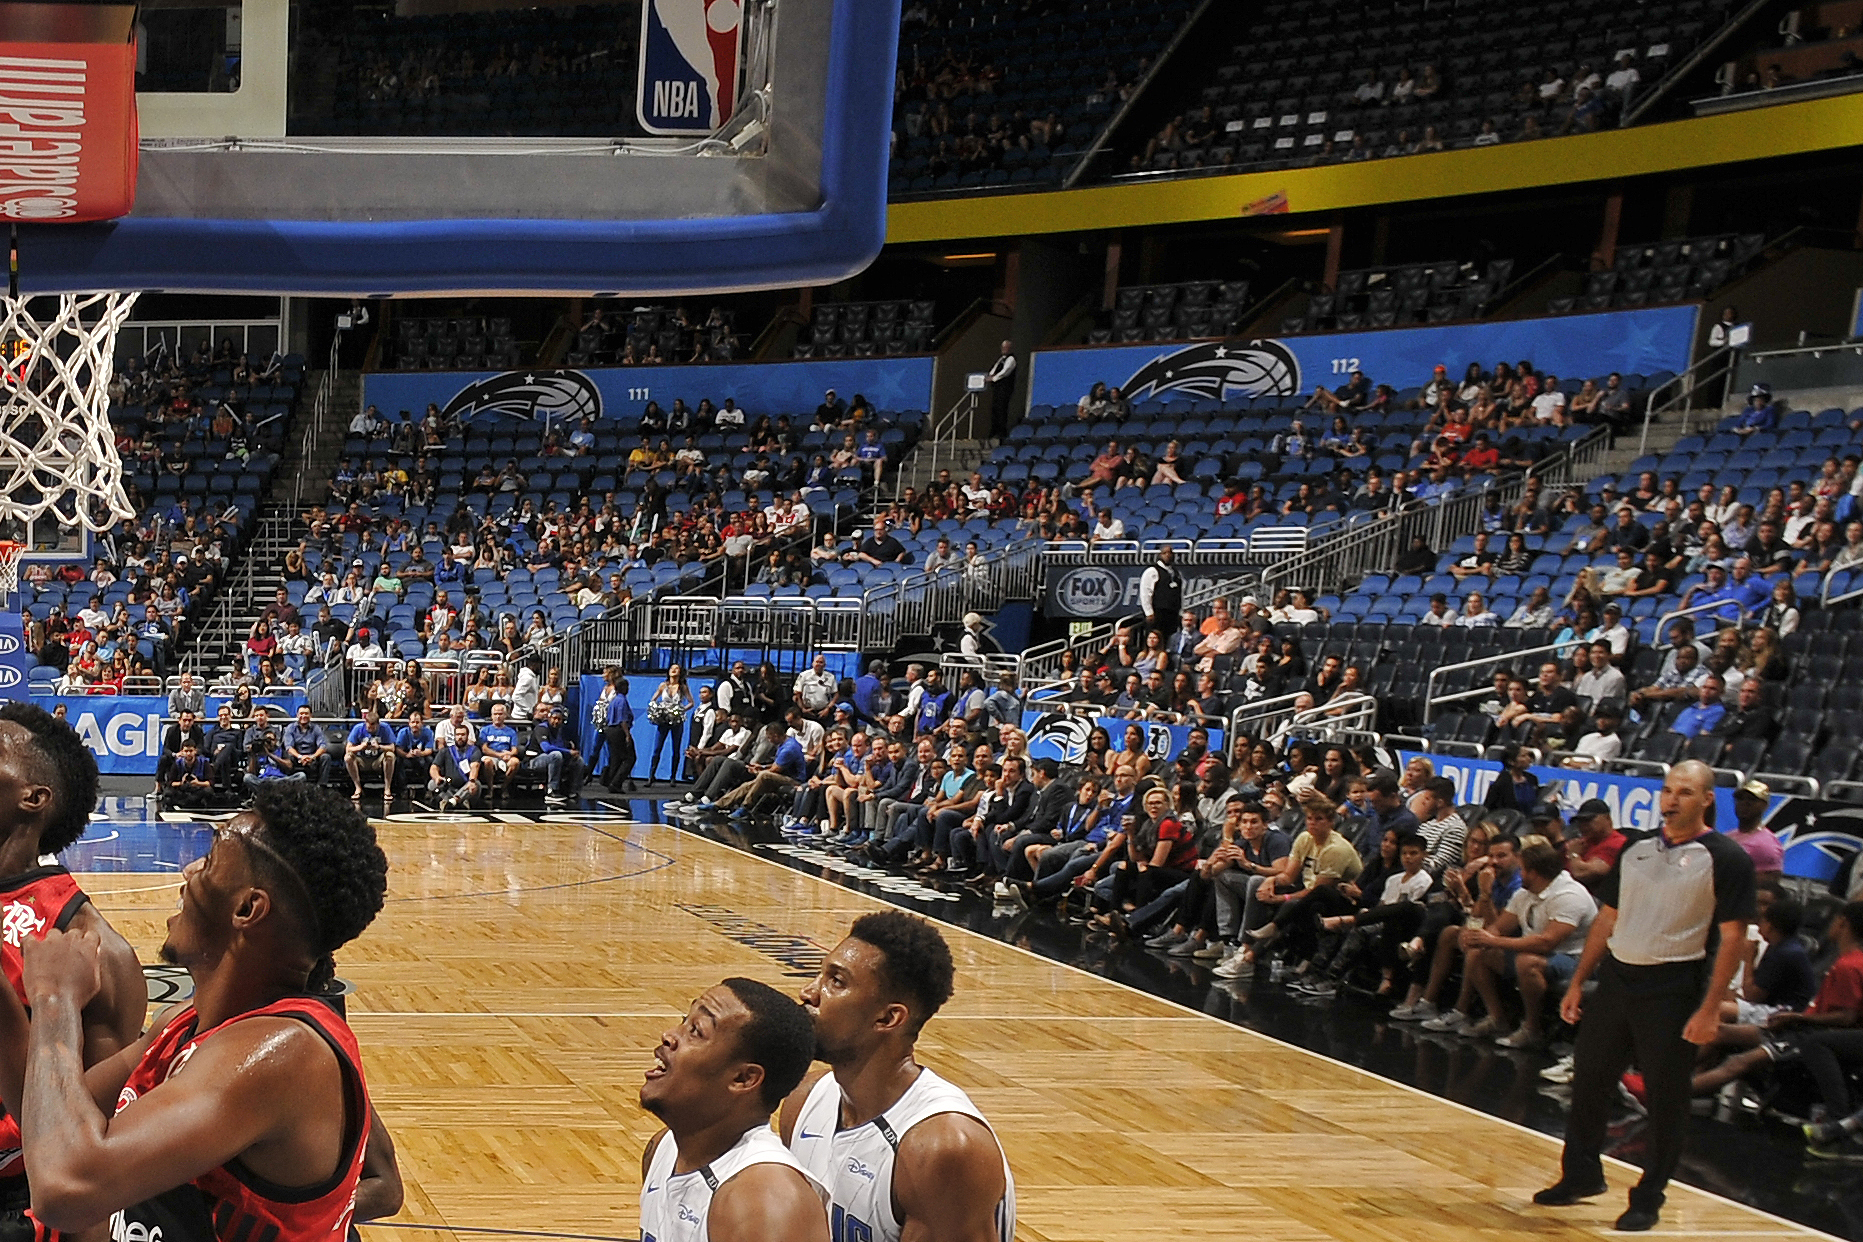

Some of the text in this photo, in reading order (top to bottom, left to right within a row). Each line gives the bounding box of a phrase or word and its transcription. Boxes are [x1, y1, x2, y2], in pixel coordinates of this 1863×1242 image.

[653, 80, 698, 118] NBA
[1331, 358, 1360, 374] 112
[628, 388, 649, 401] 111
[1071, 577, 1107, 597] FOX
[1567, 780, 1663, 831] MAGI
